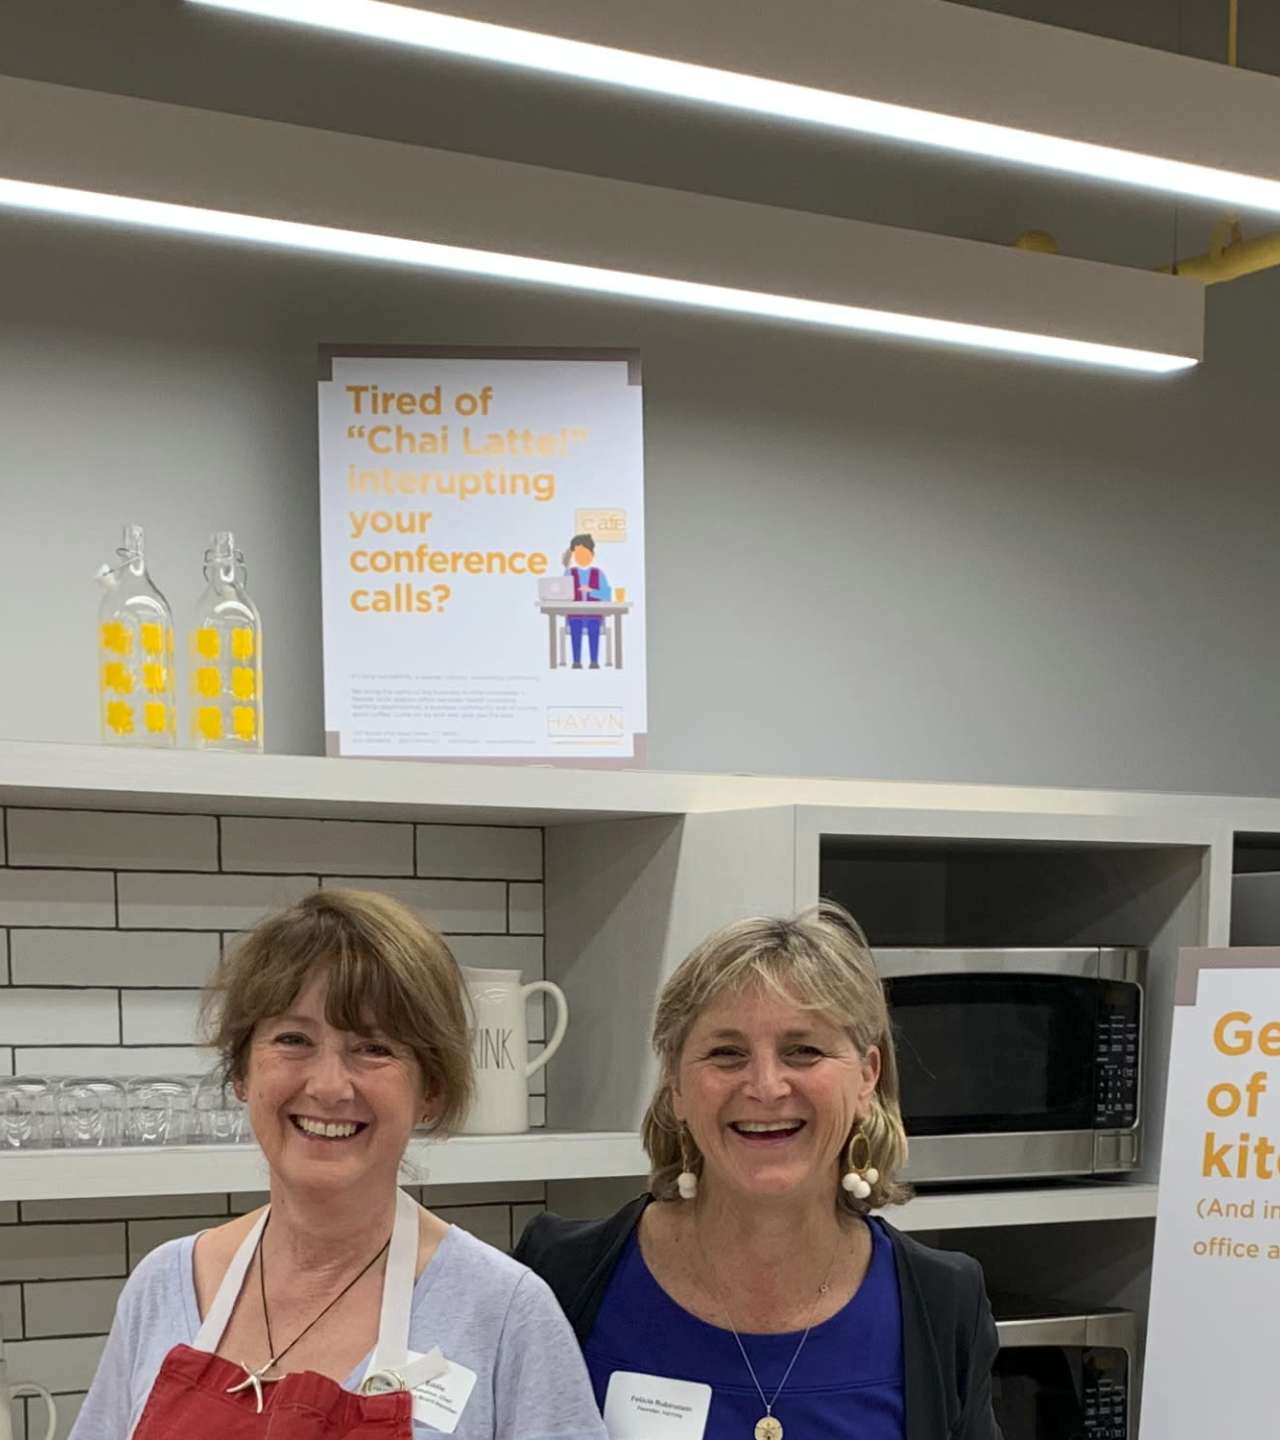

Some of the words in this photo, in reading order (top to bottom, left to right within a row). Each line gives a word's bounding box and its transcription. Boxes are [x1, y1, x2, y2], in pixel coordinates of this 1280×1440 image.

[347, 384, 442, 416] Tired
[454, 385, 493, 417] of
[348, 463, 557, 502] interupting
[349, 511, 433, 539] your
[349, 544, 549, 575] conference
[350, 583, 452, 614] calls?
[473, 1028, 515, 1070] INK
[1206, 1071, 1268, 1119] of
[1195, 1197, 1256, 1223] (And
[1192, 1236, 1261, 1260] office
